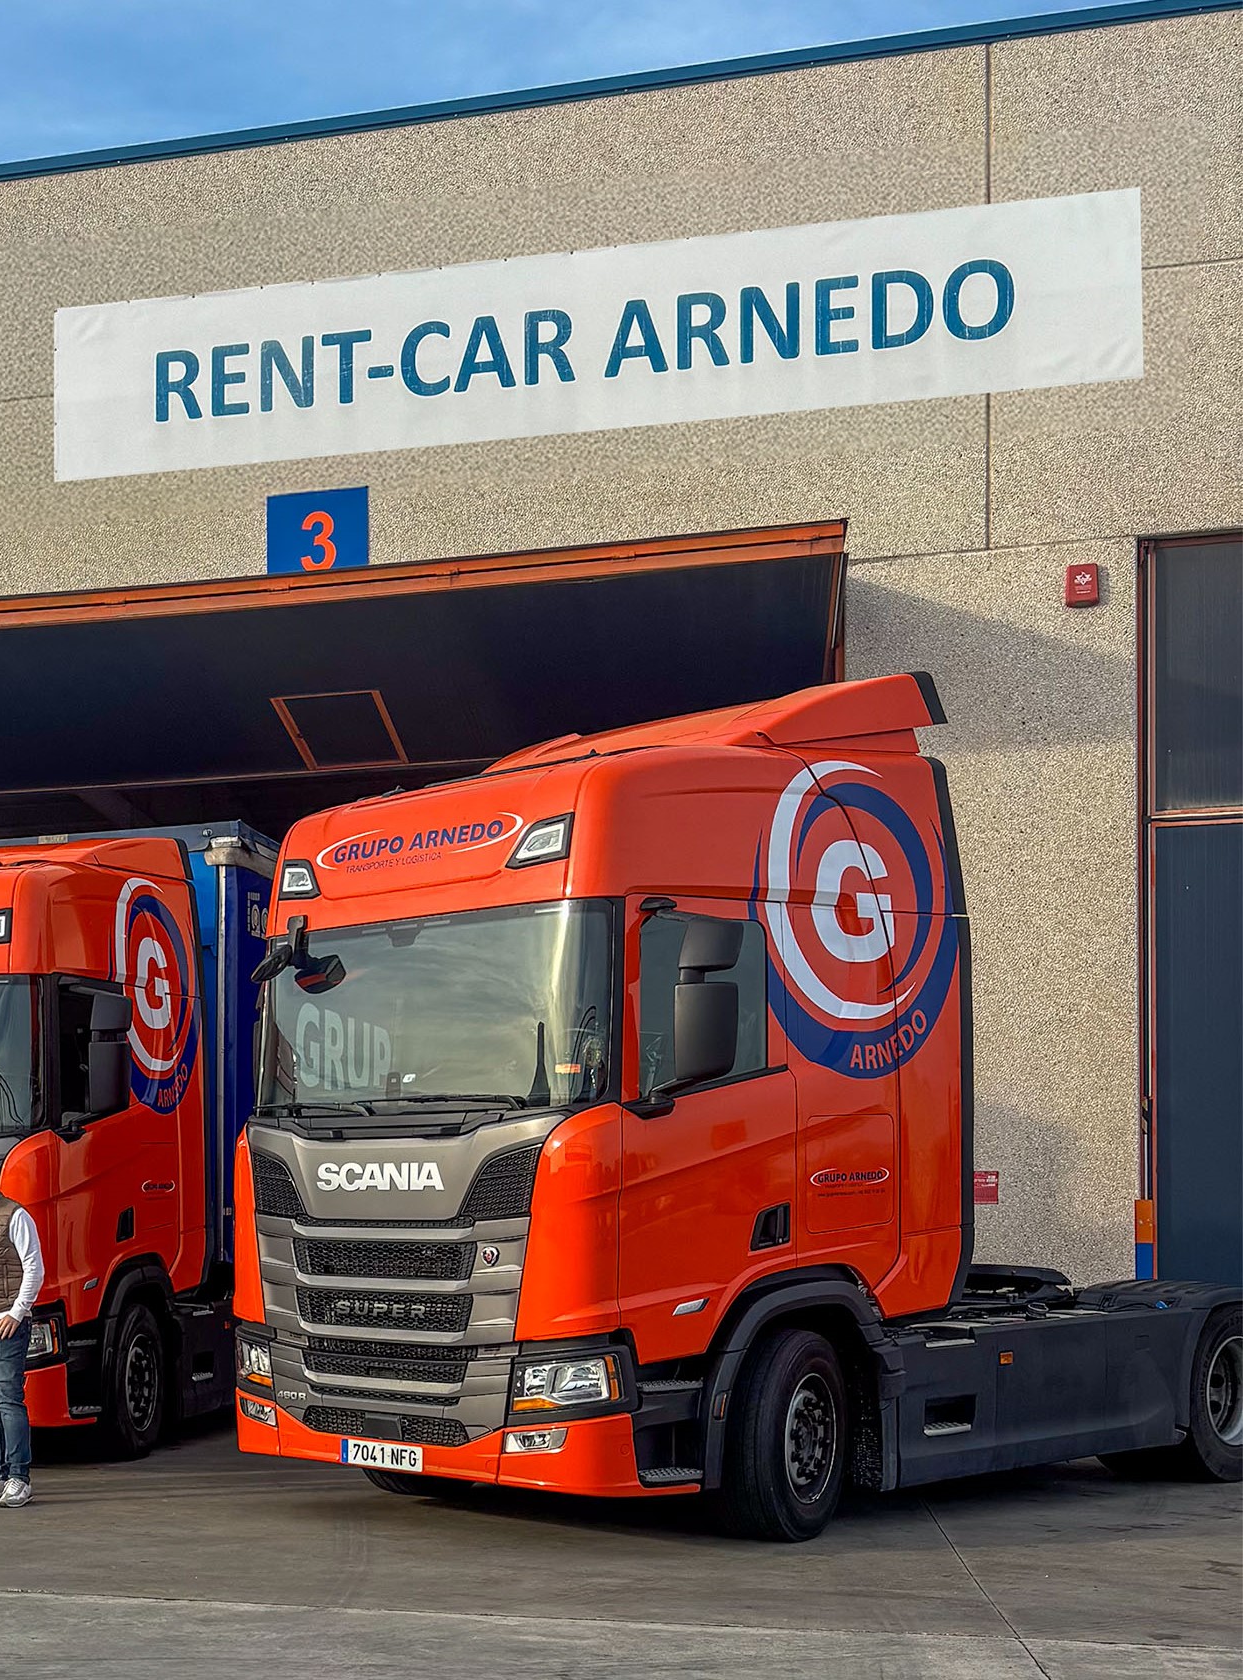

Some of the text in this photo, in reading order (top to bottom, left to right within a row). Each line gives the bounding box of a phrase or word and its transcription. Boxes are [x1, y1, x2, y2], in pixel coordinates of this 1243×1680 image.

[155, 259, 1016, 424] RENT-CAR ARNEDO
[301, 511, 337, 572] 3
[334, 819, 504, 864] GRUPO ARNEDO
[849, 1009, 927, 1070] ARNEDO
[316, 1162, 445, 1192] SCANIA
[818, 1170, 884, 1184] GRUPO ARNEDO
[335, 1300, 426, 1318] SUPER
[352, 1443, 417, 1468] 7041 NFG
